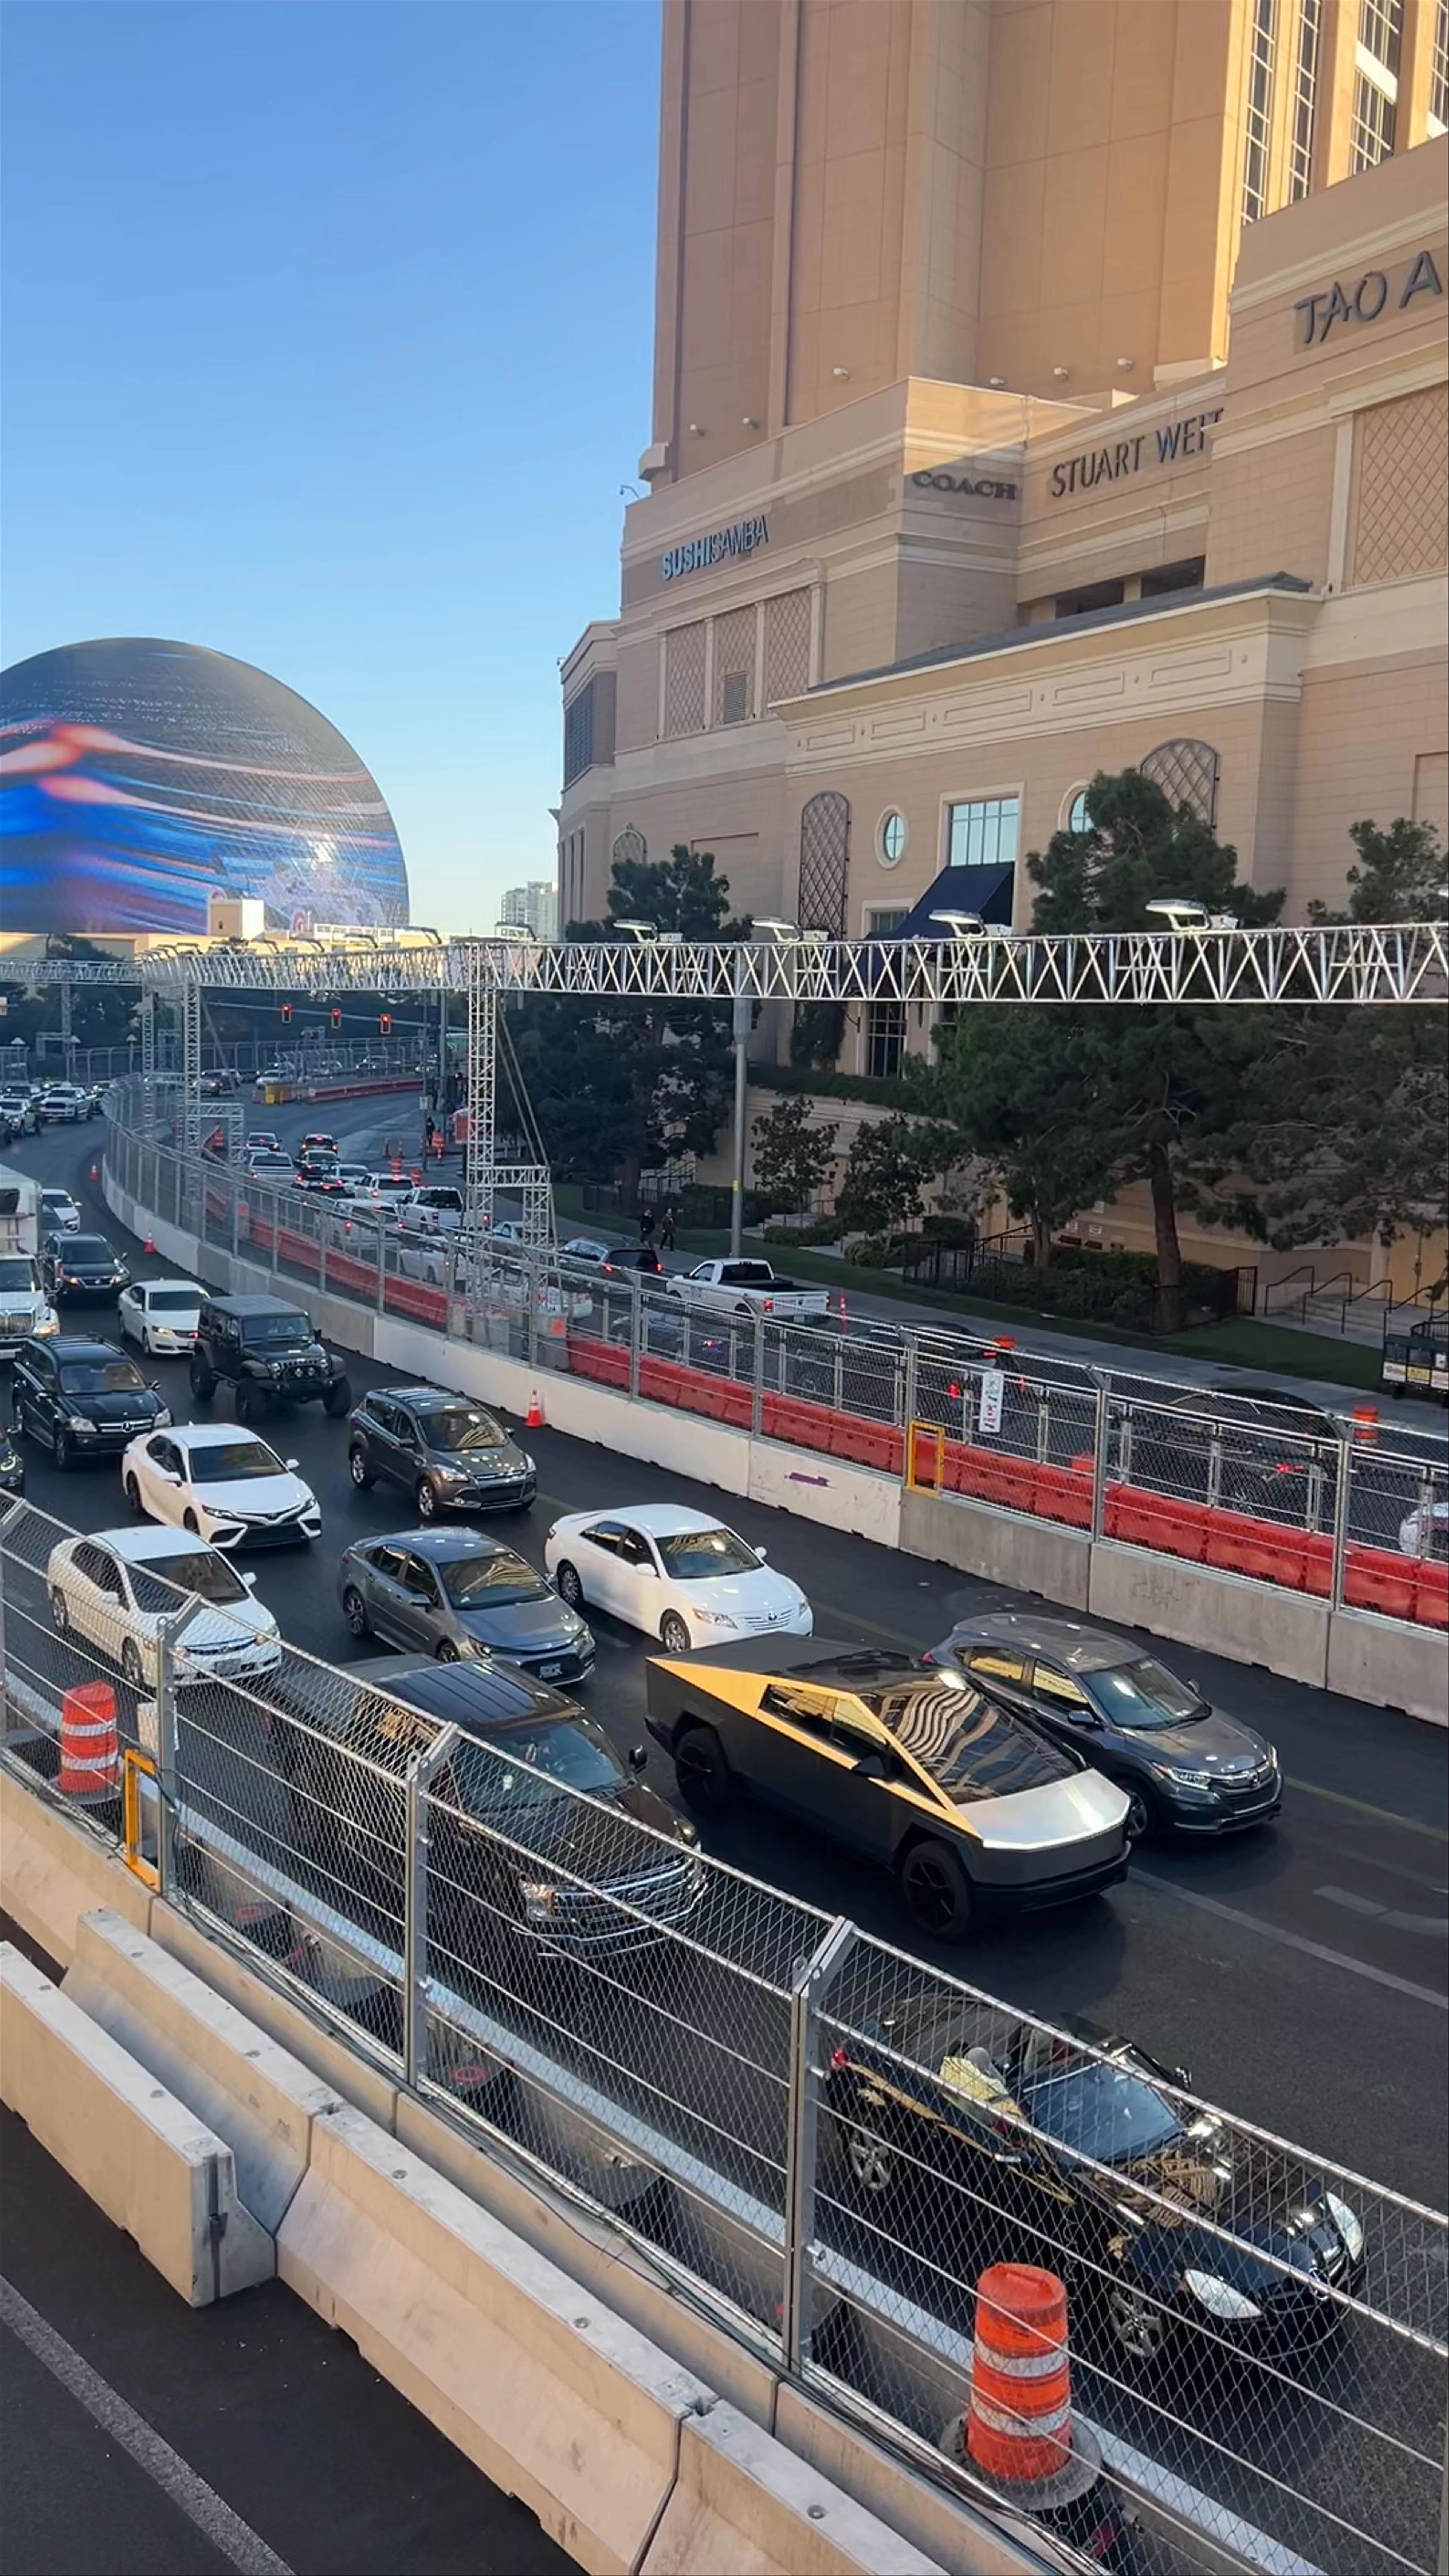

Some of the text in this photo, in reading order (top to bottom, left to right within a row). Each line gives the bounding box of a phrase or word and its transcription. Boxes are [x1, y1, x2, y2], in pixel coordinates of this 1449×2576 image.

[1293, 250, 1443, 344] TAO A
[912, 471, 1017, 500] COACH
[1052, 435, 1145, 498] STUART
[663, 515, 769, 581] SUSHISAMBA
